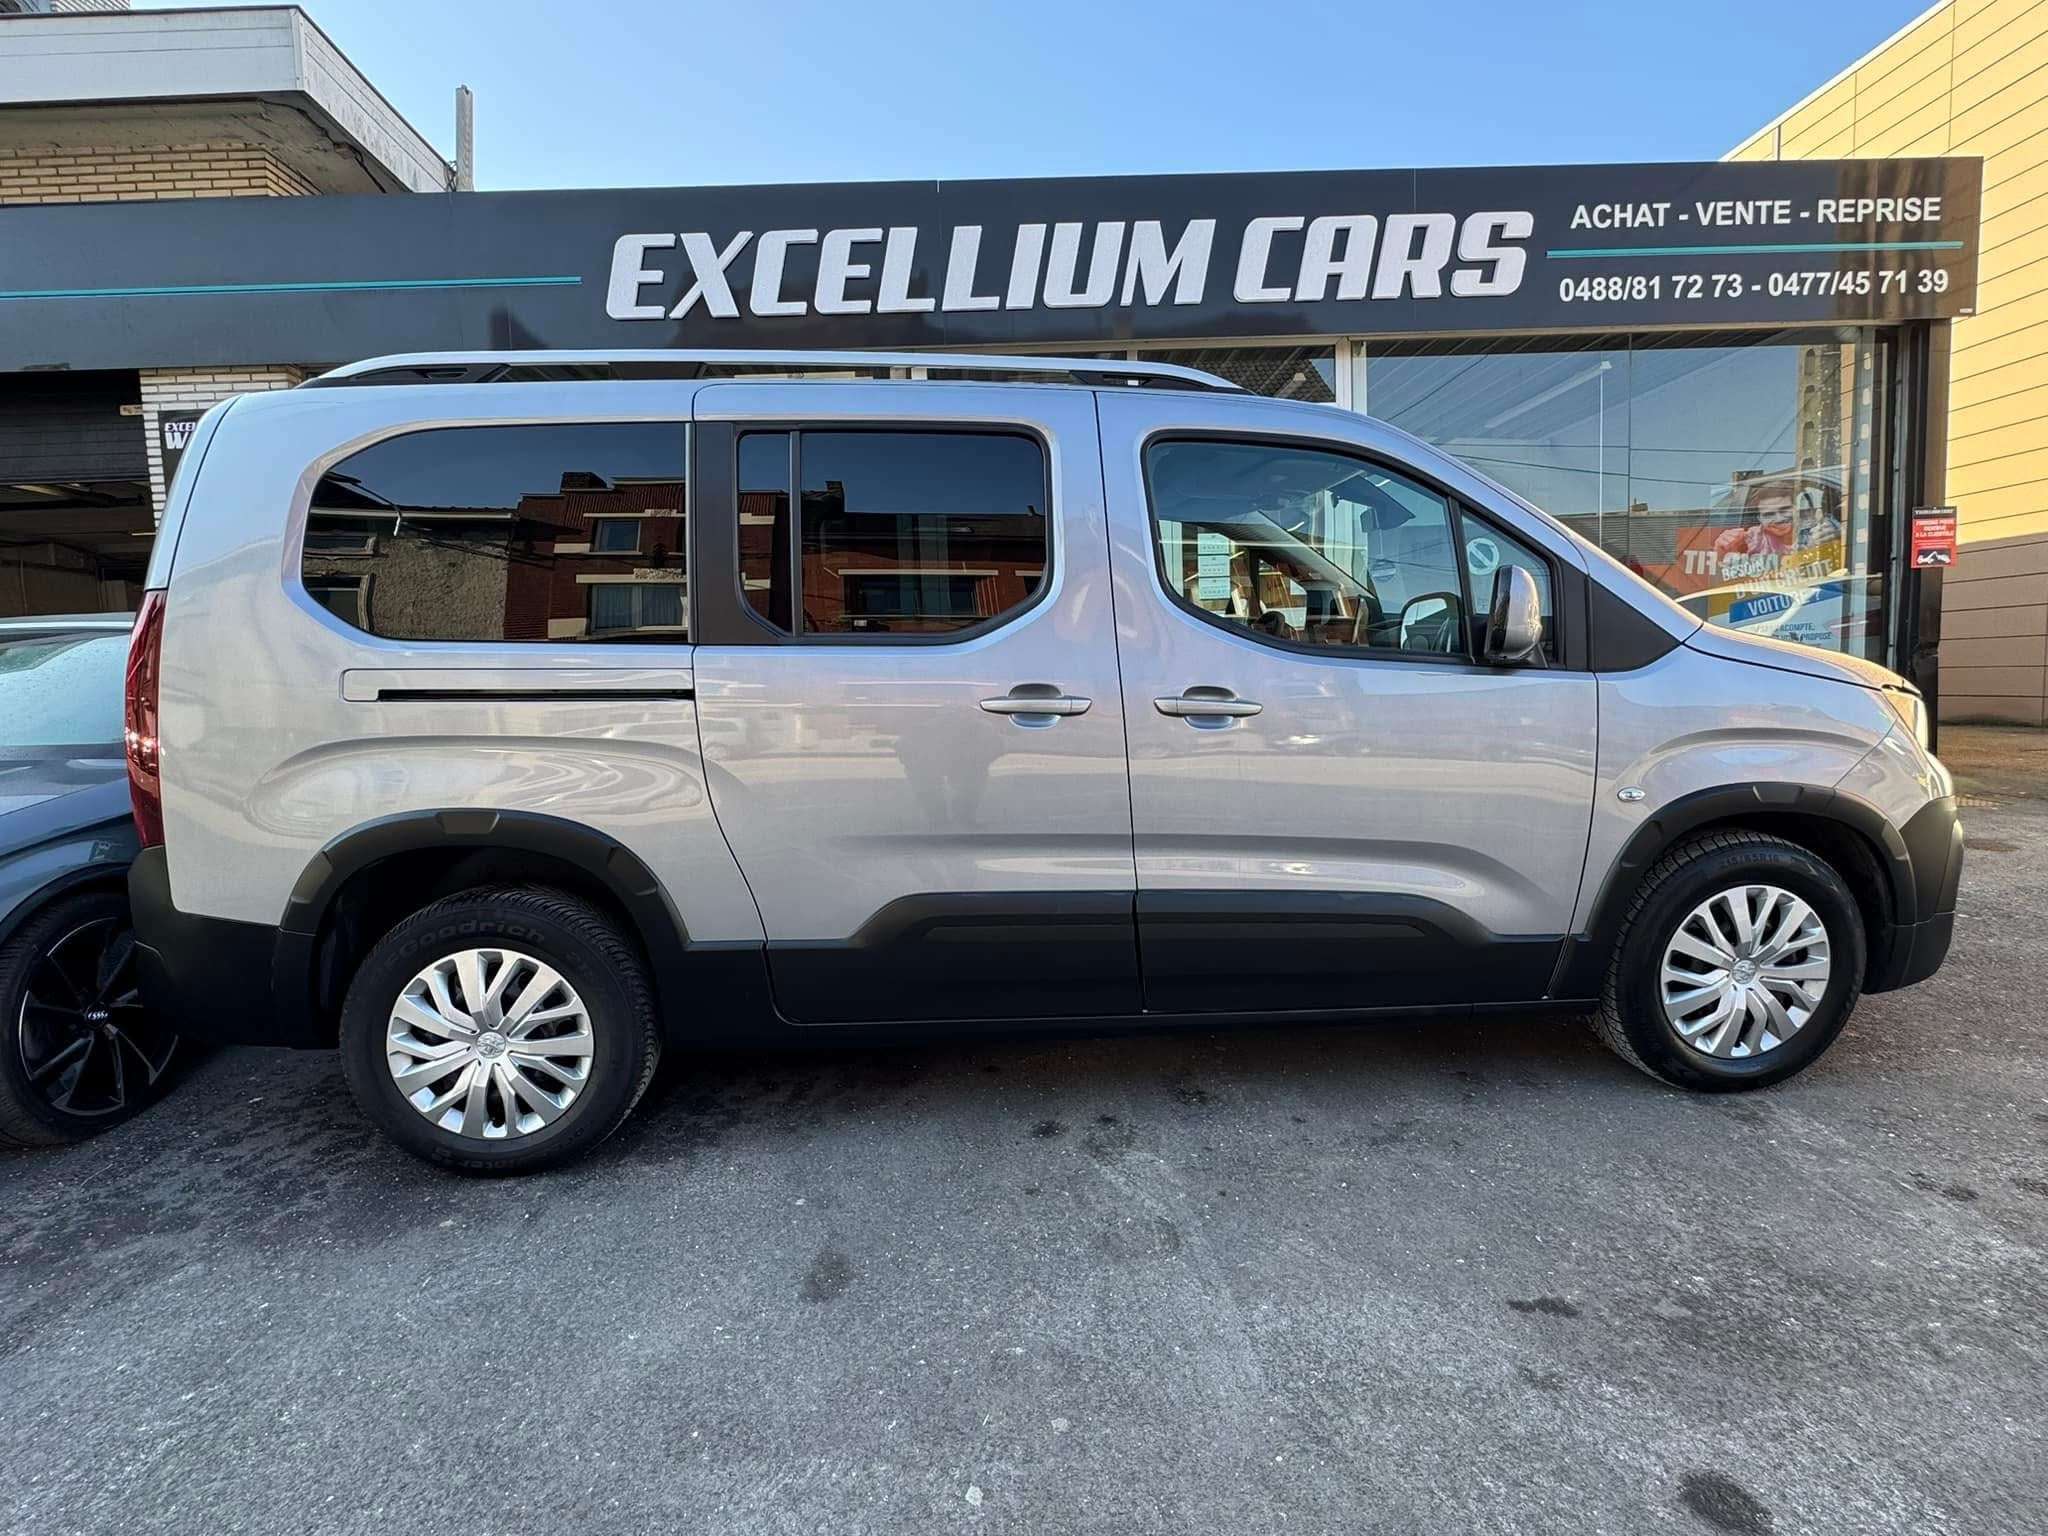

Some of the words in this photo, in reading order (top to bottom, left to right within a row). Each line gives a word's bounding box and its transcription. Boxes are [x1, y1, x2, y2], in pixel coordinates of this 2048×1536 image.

[1570, 202, 1671, 229] ACHAT
[1695, 199, 1792, 226] VENTE
[1817, 196, 1942, 224] REPRISE
[604, 218, 1218, 320] EXCELLIUM
[1232, 210, 1536, 303] CARS
[1559, 275, 1660, 302] 0488/81
[1671, 274, 1704, 299] 72
[1711, 273, 1743, 298] 73
[1768, 270, 1871, 297] 0477/45
[1878, 269, 1907, 294] 71
[1917, 268, 1949, 293] 39
